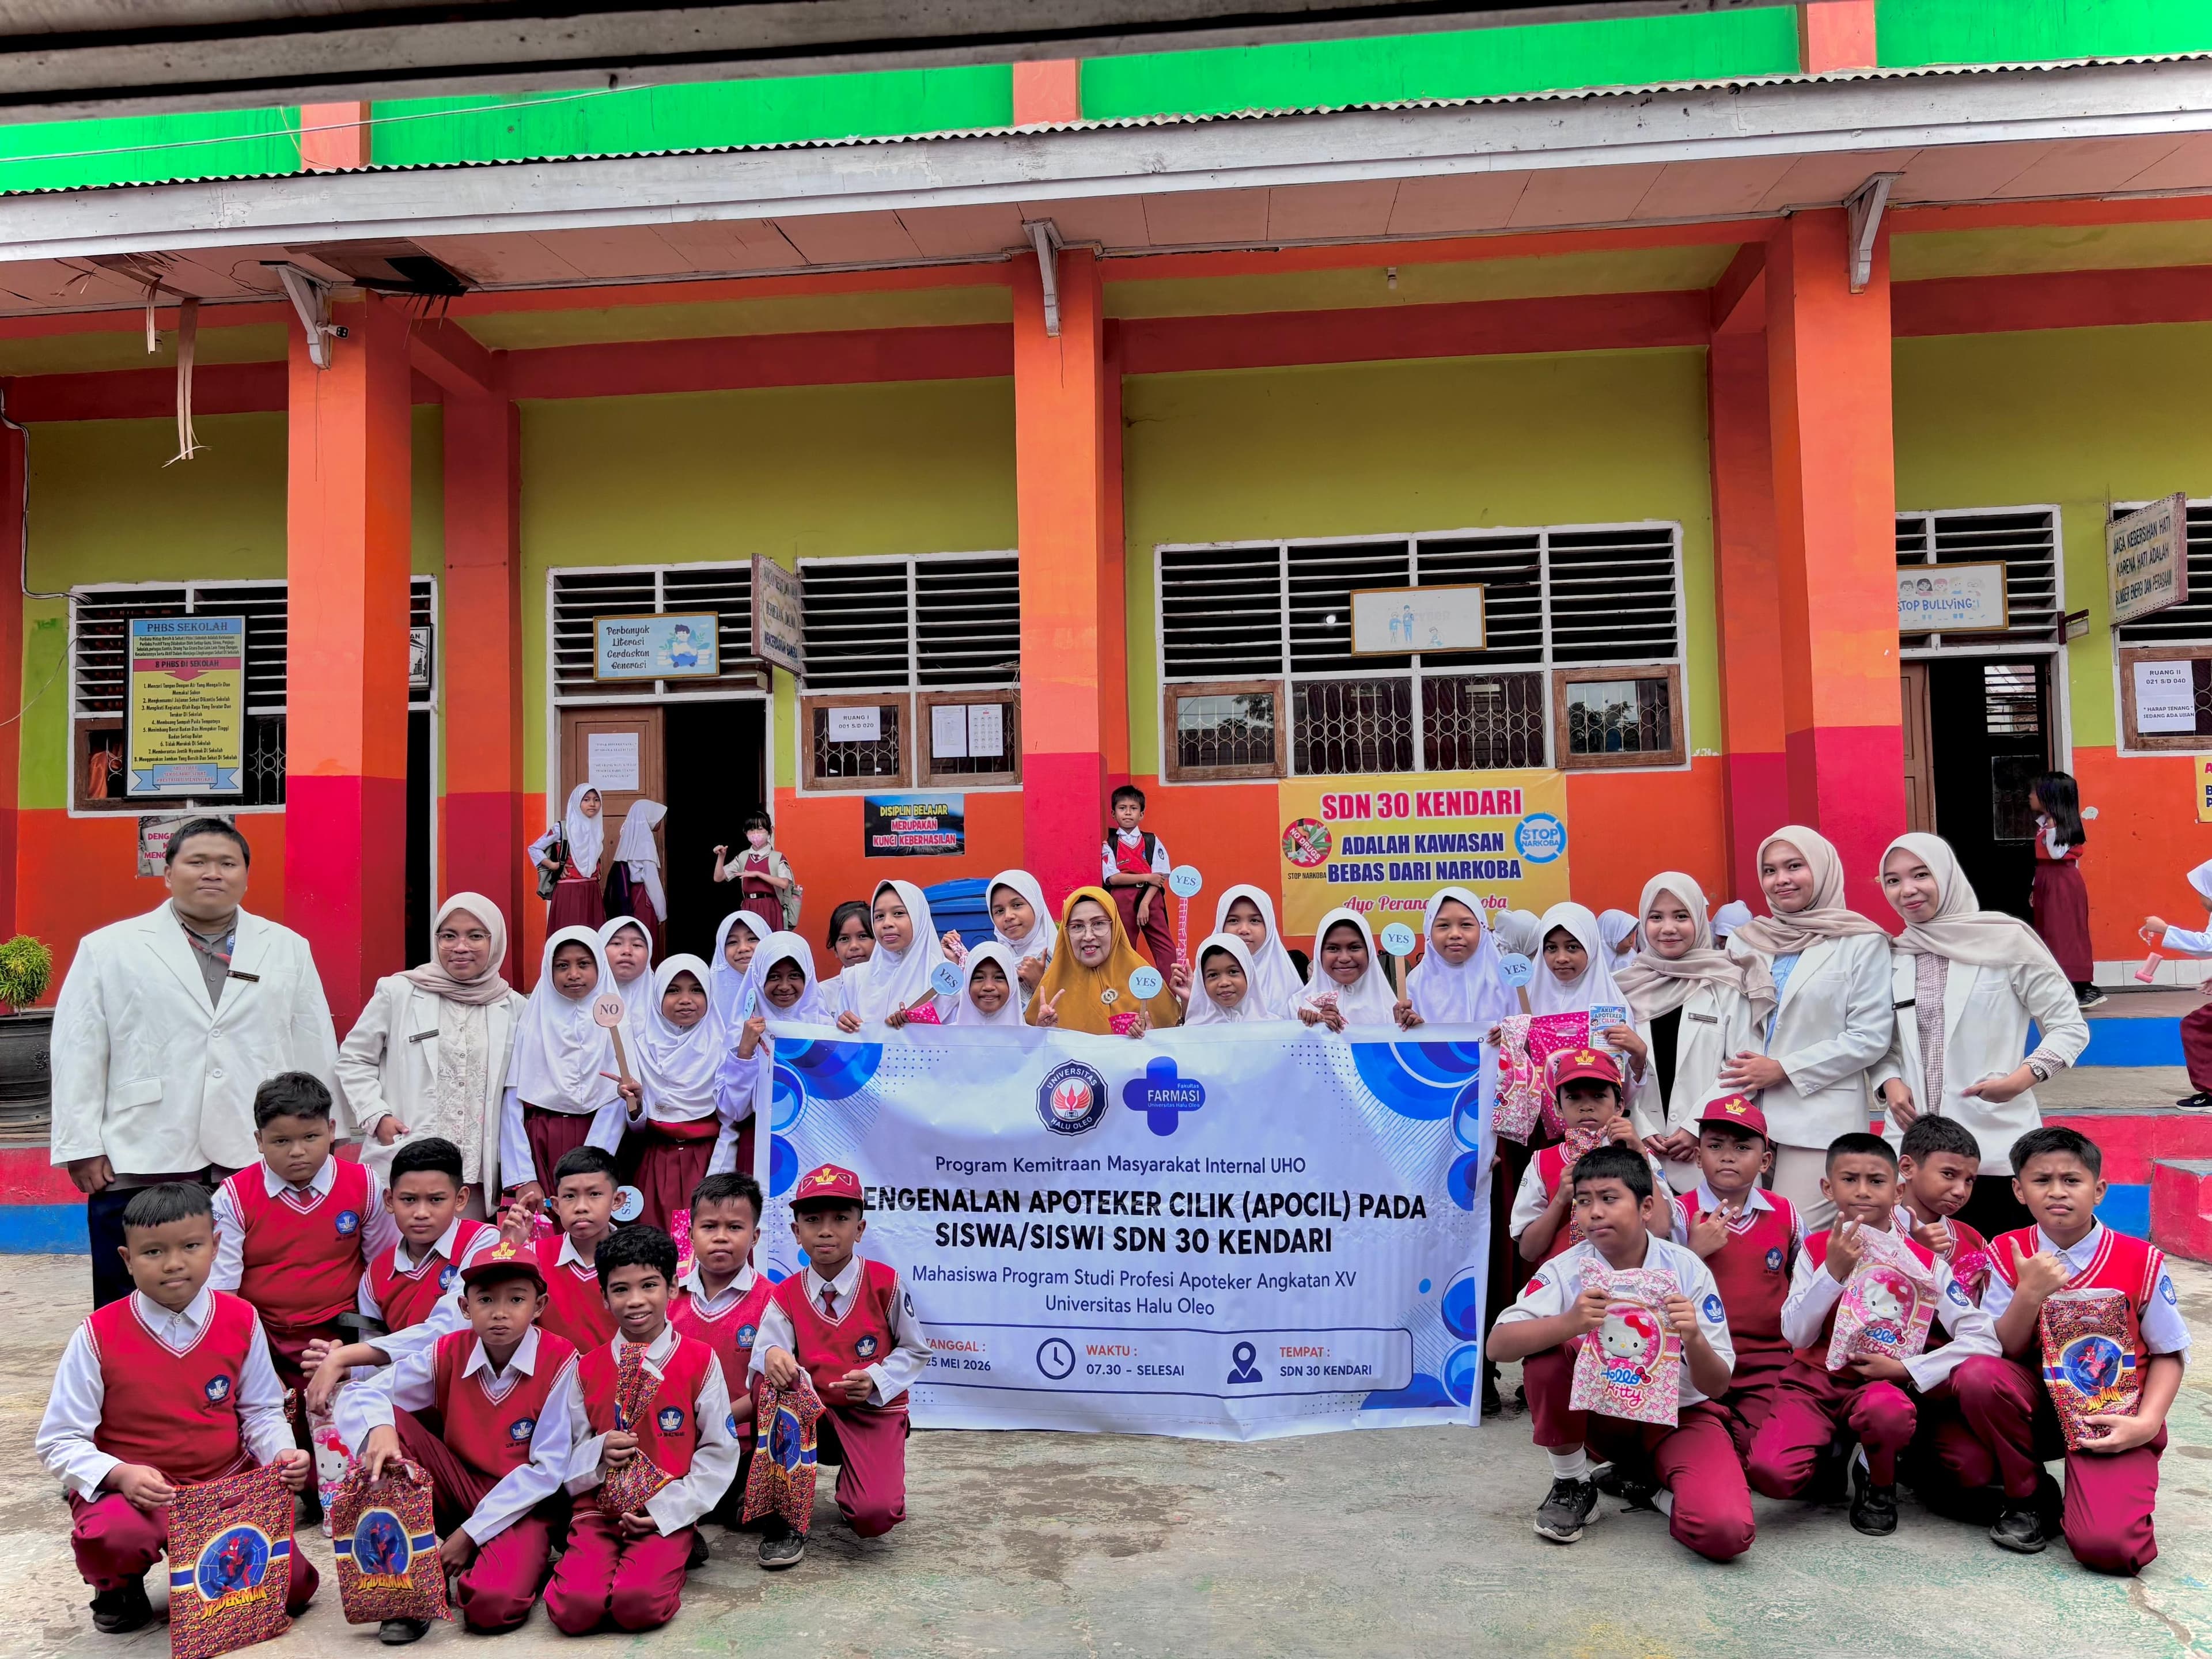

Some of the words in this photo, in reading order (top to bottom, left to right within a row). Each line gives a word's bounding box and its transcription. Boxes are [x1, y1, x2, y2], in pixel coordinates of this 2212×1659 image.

[2113, 537, 2126, 555] JAGA
[2127, 521, 2157, 547] KEBERSIHAN
[2160, 516, 2171, 535] HATI
[2116, 557, 2136, 577] KARENA
[2137, 551, 2147, 569] HATI
[2150, 543, 2169, 566] ADALAH
[1897, 600, 1920, 612] STOP
[147, 623, 175, 632] PHBS
[177, 622, 228, 631] SEKOLAH
[607, 625, 650, 637] Perbanyak
[612, 638, 645, 646] Literasi
[607, 649, 649, 658] Cerdaskan
[611, 660, 646, 669] Generasi
[880, 805, 911, 817] DISIPLIN
[914, 804, 948, 816] BELAJAR
[1322, 794, 1370, 820] SDN
[1377, 793, 1409, 818] 30
[1416, 790, 1521, 817] KENDARI
[892, 820, 937, 831] MERUPAKAN
[873, 836, 897, 846] KUNCI
[899, 834, 956, 845] KEBERHASILAN
[1522, 828, 1558, 839] STOP
[1290, 828, 1300, 838] NO
[1299, 838, 1321, 860] DRUGS
[1342, 835, 1410, 855] ADALAH
[1415, 833, 1503, 854] KAWASAN
[1328, 863, 1384, 882] BEBAS
[1389, 862, 1431, 881] DARI
[1437, 860, 1521, 880] NARKOBA
[1176, 875, 1196, 886] YES
[1344, 896, 1374, 914] Ayo
[1388, 933, 1409, 944] YES
[1504, 963, 1527, 975] YES
[940, 968, 958, 988] YES
[1135, 976, 1156, 987] YES
[600, 1004, 619, 1015] NO
[1047, 1068, 1097, 1089] UNIVERSITAS
[1147, 1090, 1199, 1102] FARMASI
[1051, 1118, 1070, 1130] HALU
[1073, 1116, 1093, 1129] OLEO
[935, 1156, 1007, 1175] Program
[1013, 1157, 1101, 1172] Kemitraan
[1107, 1155, 1200, 1176] Masyarakat
[1206, 1157, 1266, 1173] Internal
[1271, 1157, 1306, 1173] UHO
[863, 1187, 1020, 1213] ENGENALAN
[1028, 1190, 1161, 1216] APOTEKER
[1169, 1191, 1235, 1218] CILIK
[1243, 1190, 1350, 1222] (APOCIL)
[1359, 1194, 1427, 1219] PADA
[935, 1222, 1104, 1251] SISWA/SISWI
[1113, 1226, 1165, 1252] SDN
[1175, 1228, 1209, 1253] 30
[1219, 1228, 1331, 1255] KENDARI
[912, 1265, 997, 1282] Mahasiswa
[1003, 1267, 1069, 1287] Program
[1074, 1268, 1114, 1286] Studi
[1120, 1270, 1174, 1287] Profesi
[1179, 1271, 1252, 1291] Apoteker
[1257, 1271, 1330, 1292] Angkatan
[1335, 1271, 1357, 1287] XV
[1046, 1294, 1131, 1313] Universitas
[1137, 1297, 1172, 1314] Halu
[1177, 1298, 1215, 1315] Oleo
[1086, 1344, 1130, 1357] WAKTU
[1279, 1347, 1324, 1358] TEMPAT
[941, 1358, 960, 1369] MEI
[963, 1359, 991, 1371] 2026
[1086, 1364, 1121, 1375] 07.30
[1137, 1365, 1184, 1377] SELESAI
[1280, 1366, 1303, 1376] SDN
[1306, 1366, 1320, 1376] 30
[1324, 1365, 1372, 1376] KENDARI
[1606, 1382, 1642, 1407] Kitty
